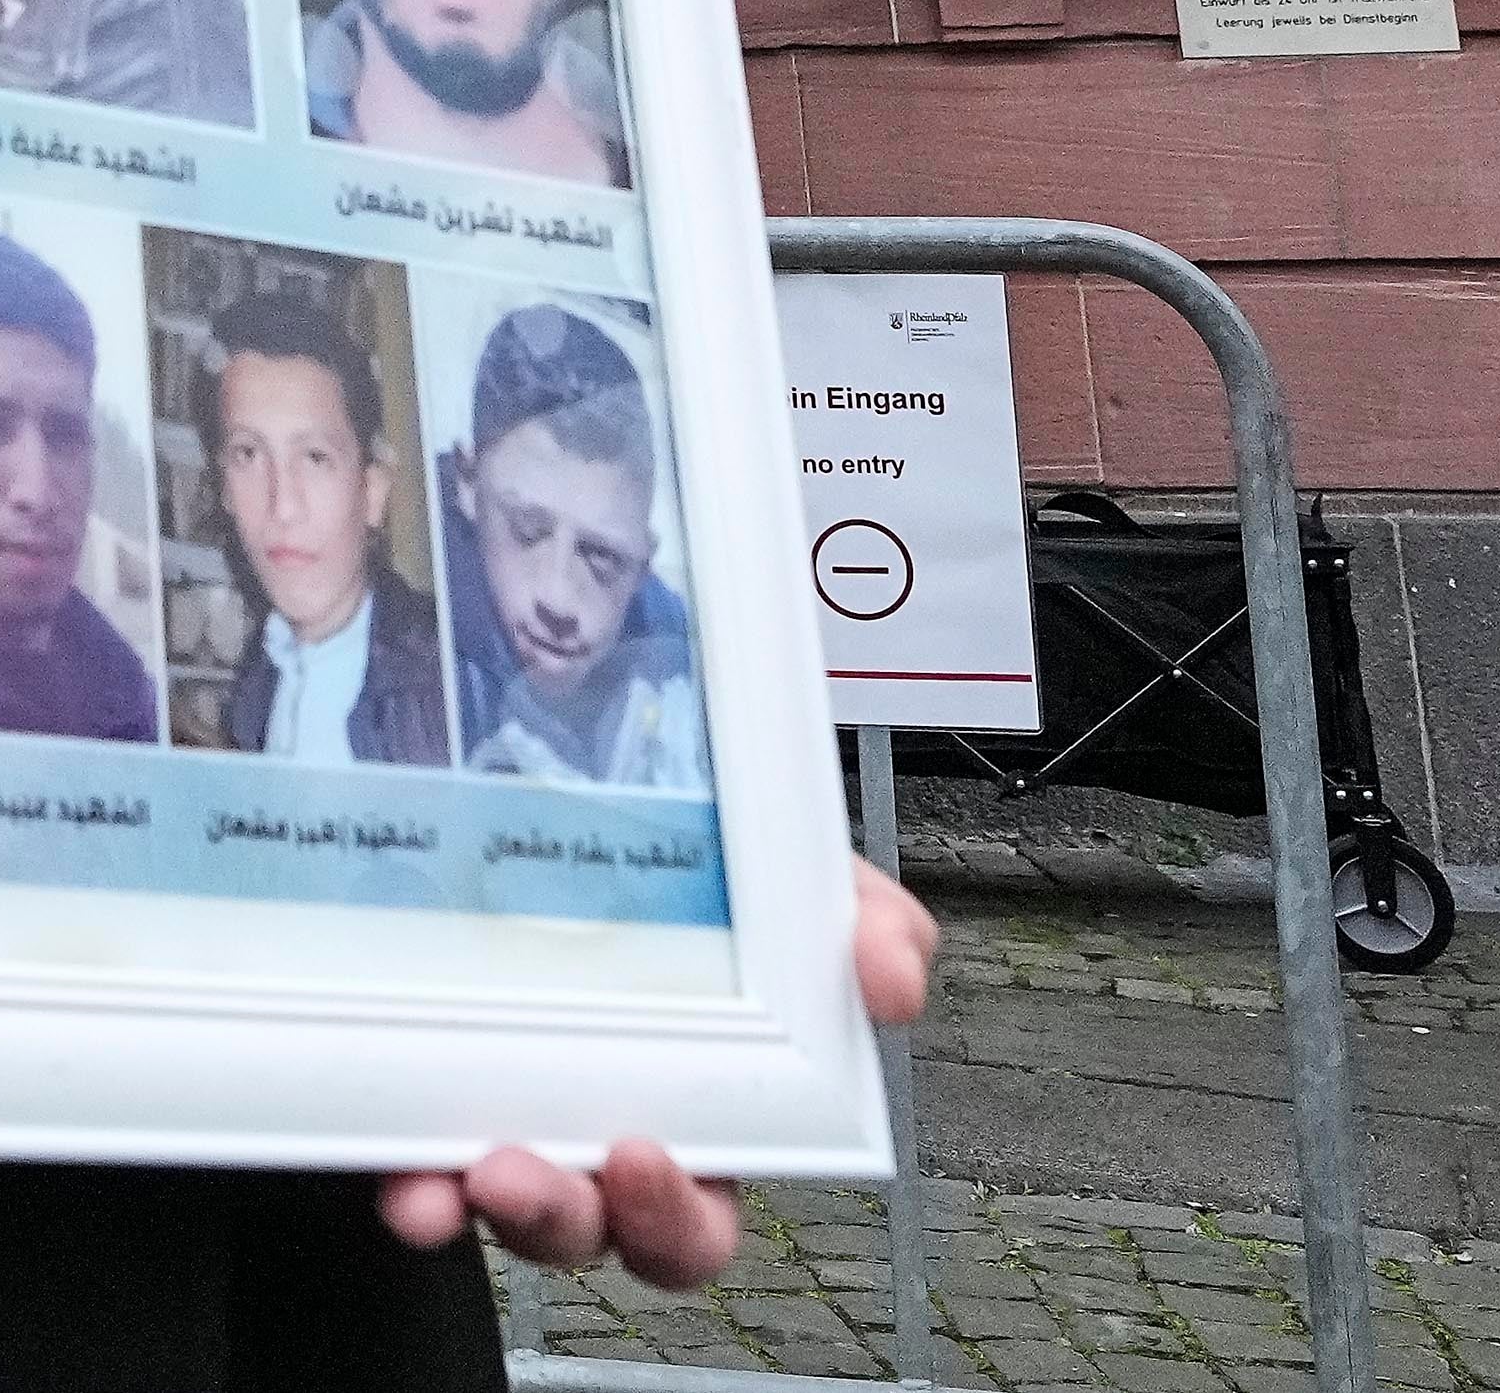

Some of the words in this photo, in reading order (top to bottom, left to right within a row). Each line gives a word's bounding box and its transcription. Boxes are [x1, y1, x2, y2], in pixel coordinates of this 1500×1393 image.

[1215, 17, 1264, 29] Leerung
[1271, 15, 1312, 29] jeweils
[1319, 14, 1337, 26] bei
[1343, 12, 1419, 26] Dienstbeginn
[94, 145, 197, 184] الشهيد
[333, 181, 428, 222] مشعان
[522, 214, 614, 250] الشهيد
[787, 386, 817, 410] in
[826, 386, 945, 416] Eingang
[802, 458, 833, 474] no
[841, 455, 906, 480] entry
